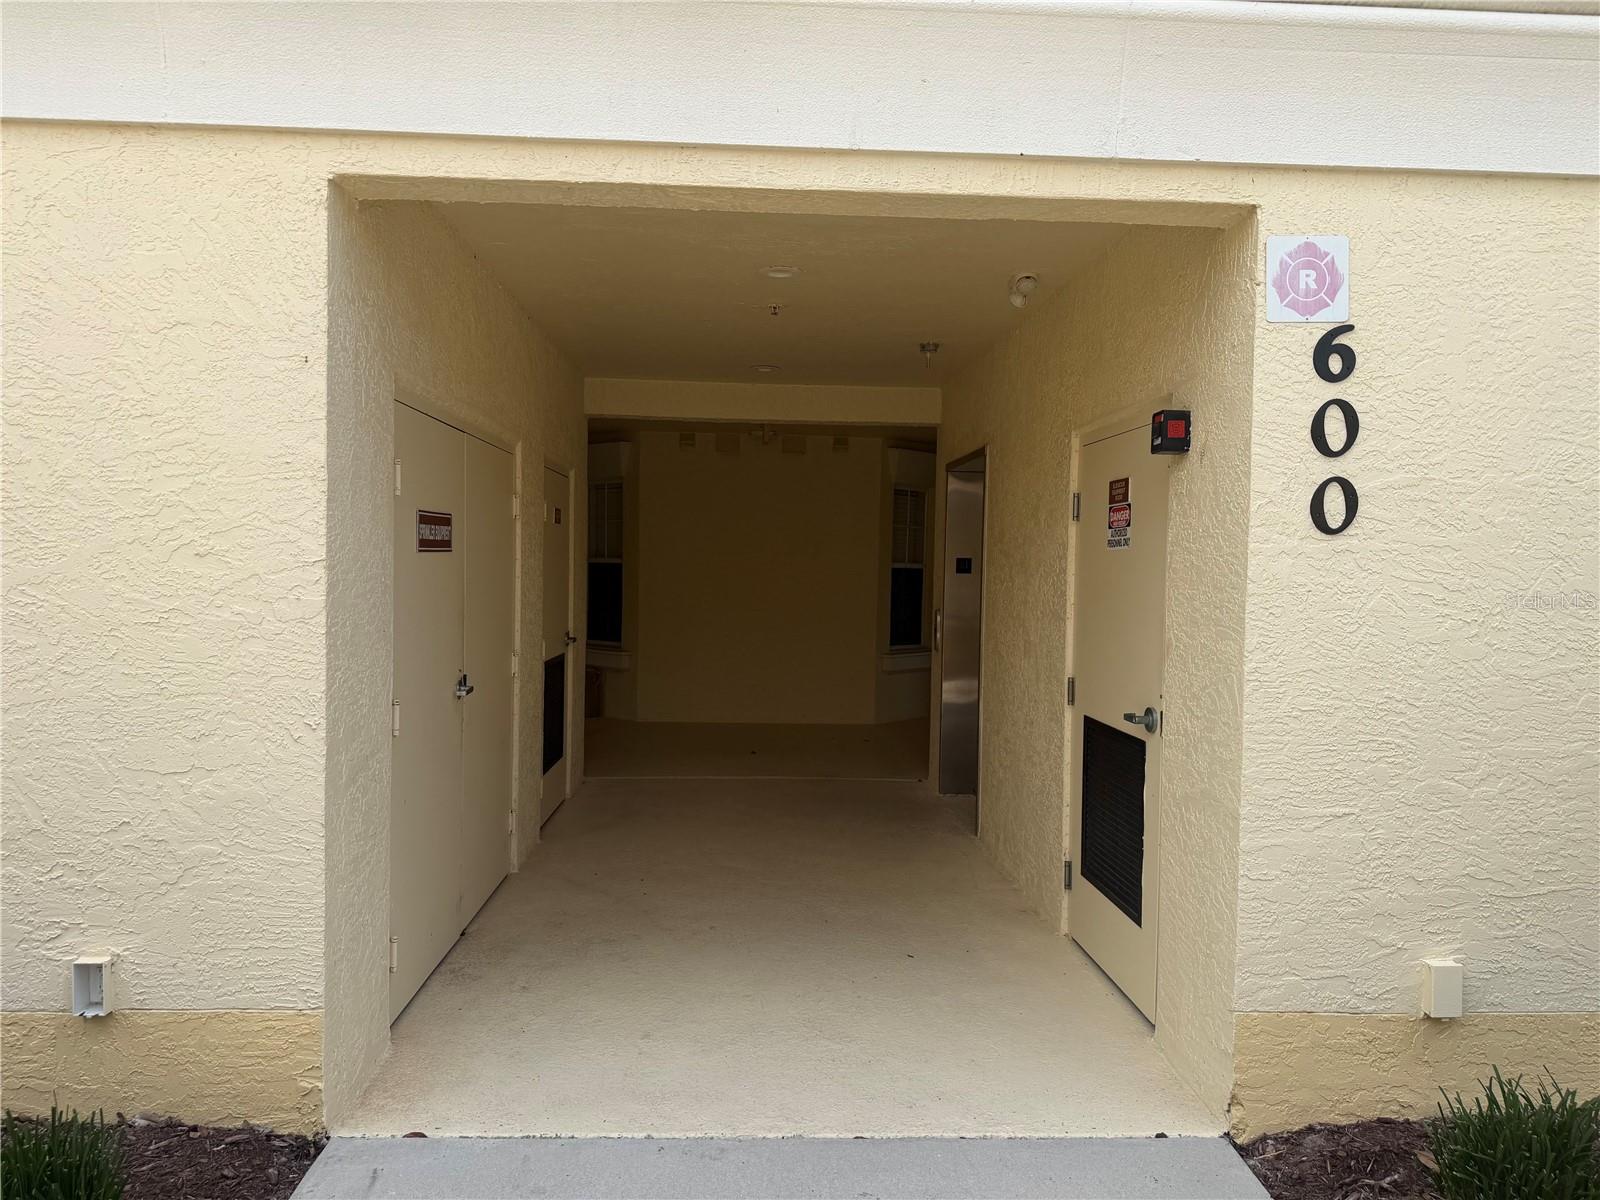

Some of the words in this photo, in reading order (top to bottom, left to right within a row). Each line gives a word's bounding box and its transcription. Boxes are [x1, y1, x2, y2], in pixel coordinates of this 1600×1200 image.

[1299, 269, 1317, 289] R
[1310, 324, 1359, 535] 600
[1110, 510, 1130, 522] DANGER
